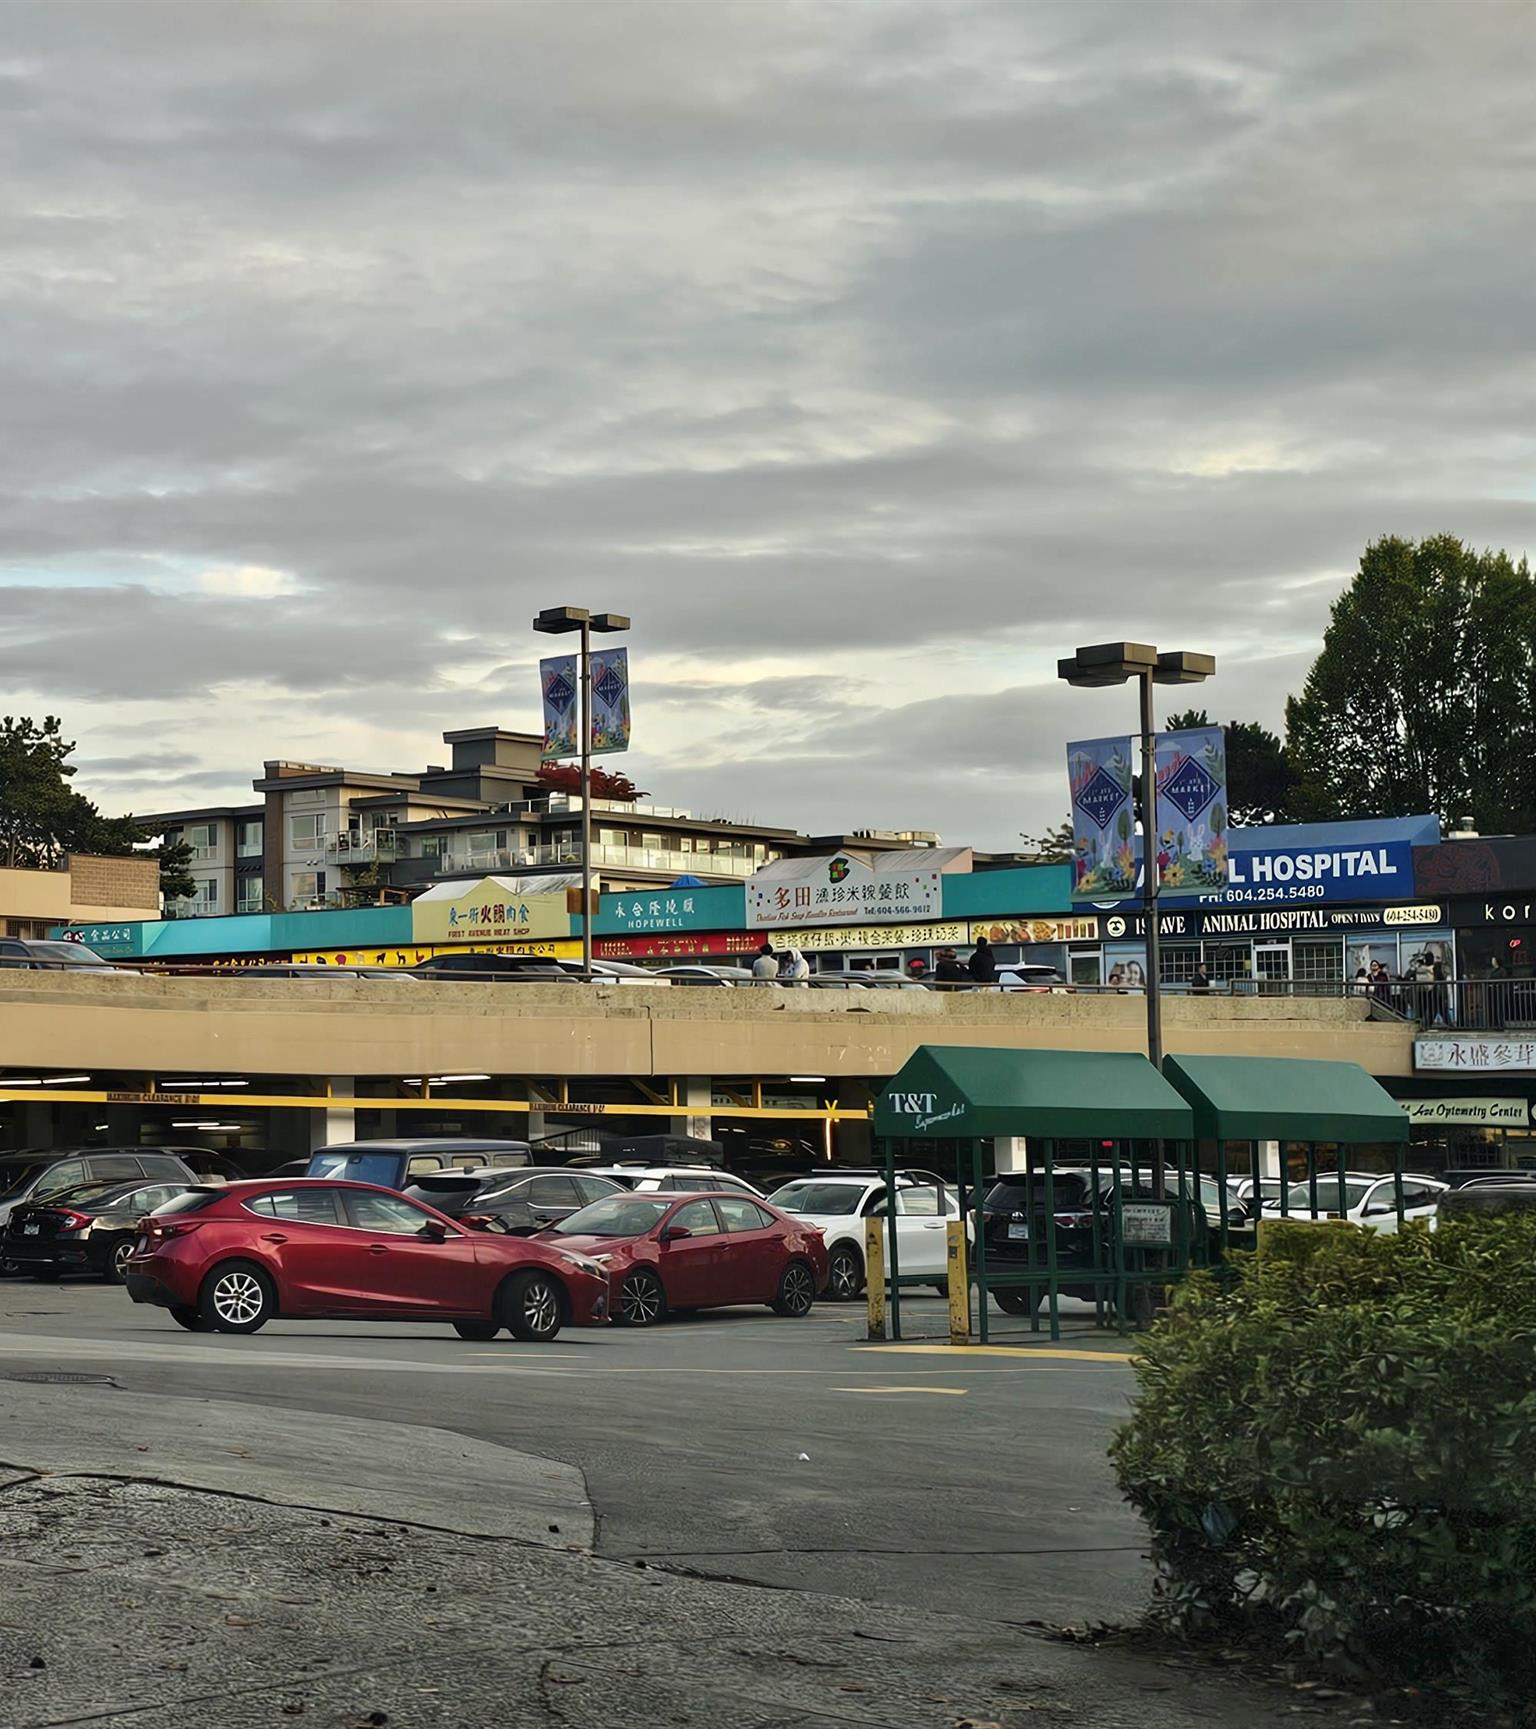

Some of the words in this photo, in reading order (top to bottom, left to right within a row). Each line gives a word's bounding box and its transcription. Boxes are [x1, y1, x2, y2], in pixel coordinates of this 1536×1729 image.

[1253, 849, 1397, 882] HOSPITAL
[1226, 885, 1324, 902] 604.254.5480
[628, 918, 683, 928] HOPEWELL
[1159, 916, 1185, 934] AVE
[1202, 913, 1257, 933] ANIMAL
[1260, 910, 1329, 930] HOSPITAL
[889, 1093, 937, 1113] T&T
[1436, 1103, 1487, 1119] Optometry
[1490, 1104, 1522, 1117] Center
